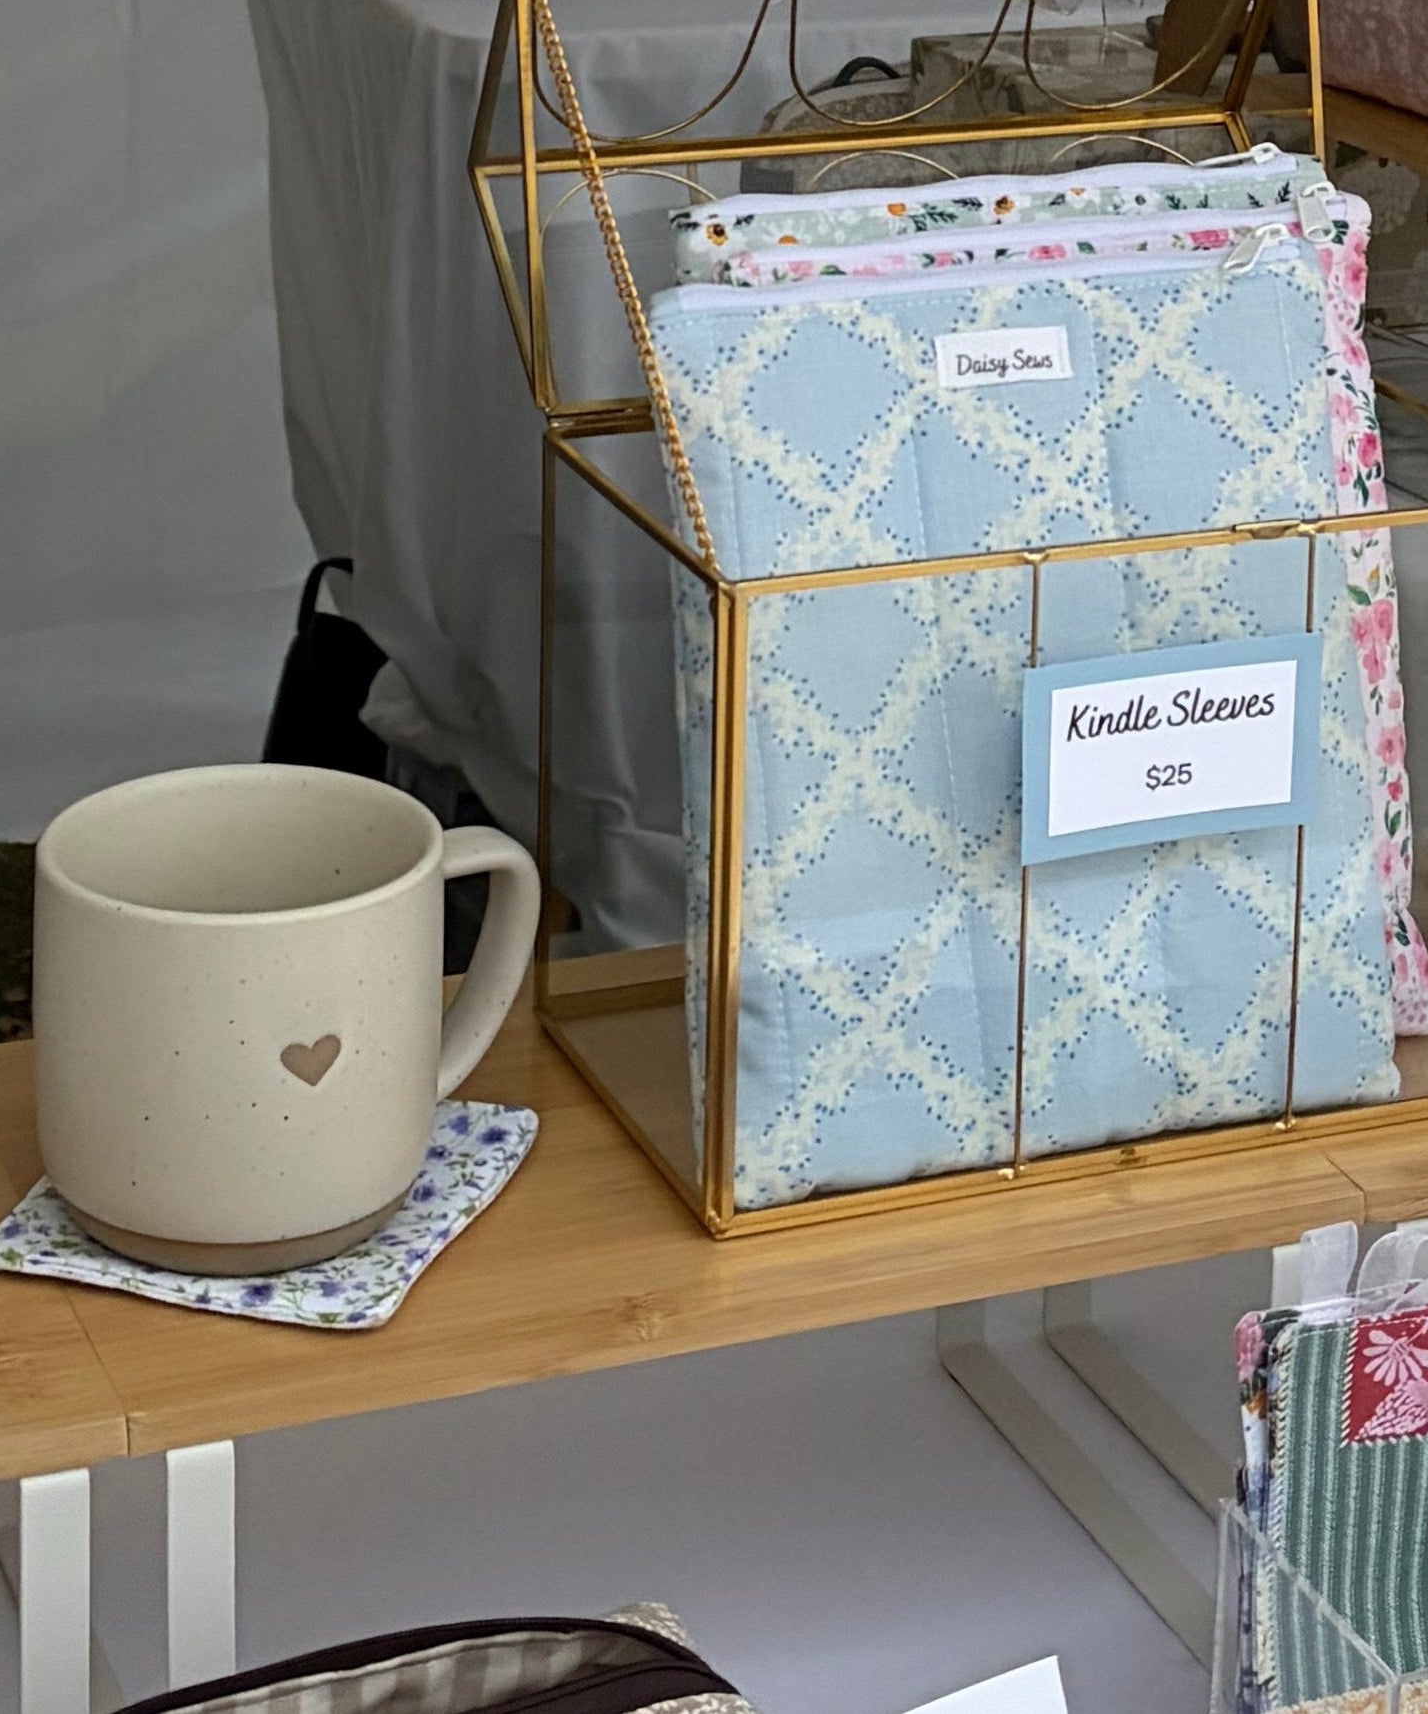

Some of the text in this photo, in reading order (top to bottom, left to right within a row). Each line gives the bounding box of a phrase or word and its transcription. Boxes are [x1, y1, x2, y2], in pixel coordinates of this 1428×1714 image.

[956, 347, 1054, 378] Daisy Sews
[1065, 686, 1276, 743] Kindle Sleeves
[1145, 762, 1194, 791] $25
